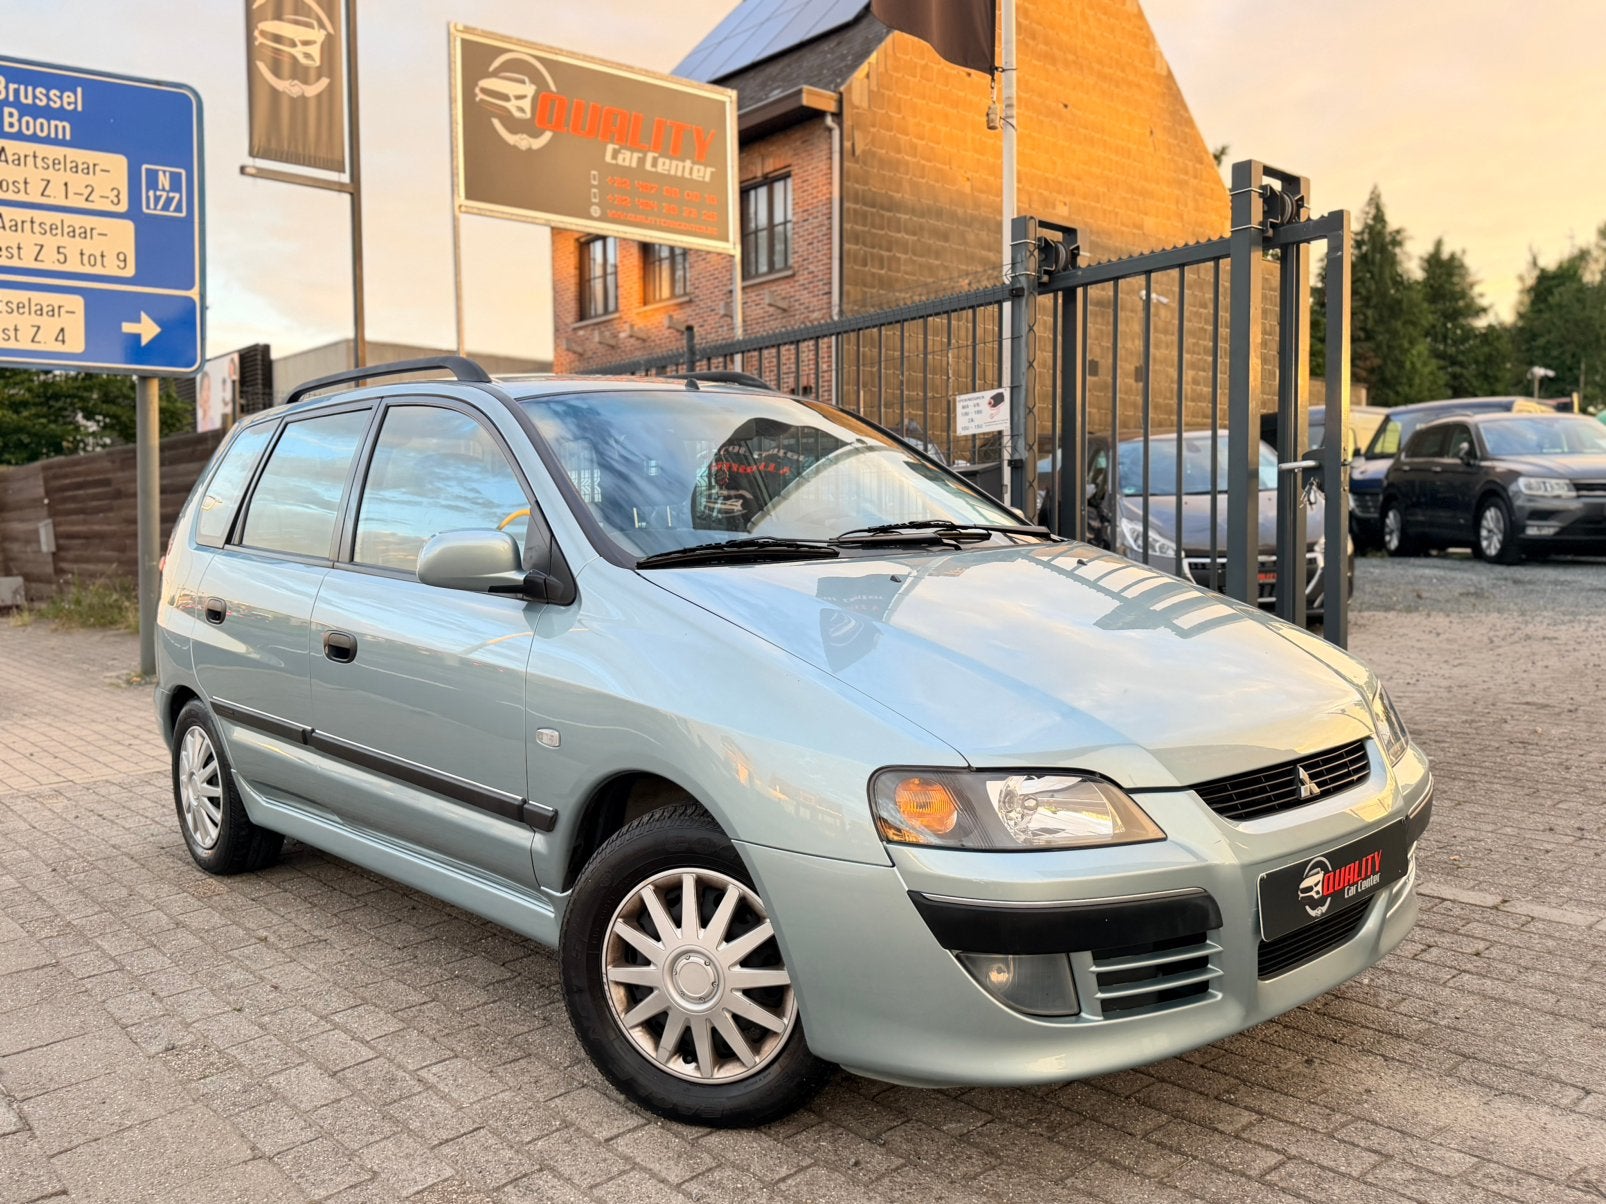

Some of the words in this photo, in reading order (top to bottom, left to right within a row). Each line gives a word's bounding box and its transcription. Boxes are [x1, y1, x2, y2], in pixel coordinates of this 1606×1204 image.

[3, 106, 71, 140] Boom
[535, 91, 716, 162] QUALITY
[0, 146, 110, 176] Aartselaar-
[604, 143, 643, 168] Car
[645, 151, 716, 182] Center
[158, 170, 170, 190] N
[148, 189, 180, 211] 177
[79, 248, 107, 268] tot
[116, 251, 128, 270] 9
[0, 297, 77, 318] selaar-
[1323, 849, 1382, 896] QUALITY
[1344, 885, 1357, 898] Car
[1358, 873, 1380, 892] Center
